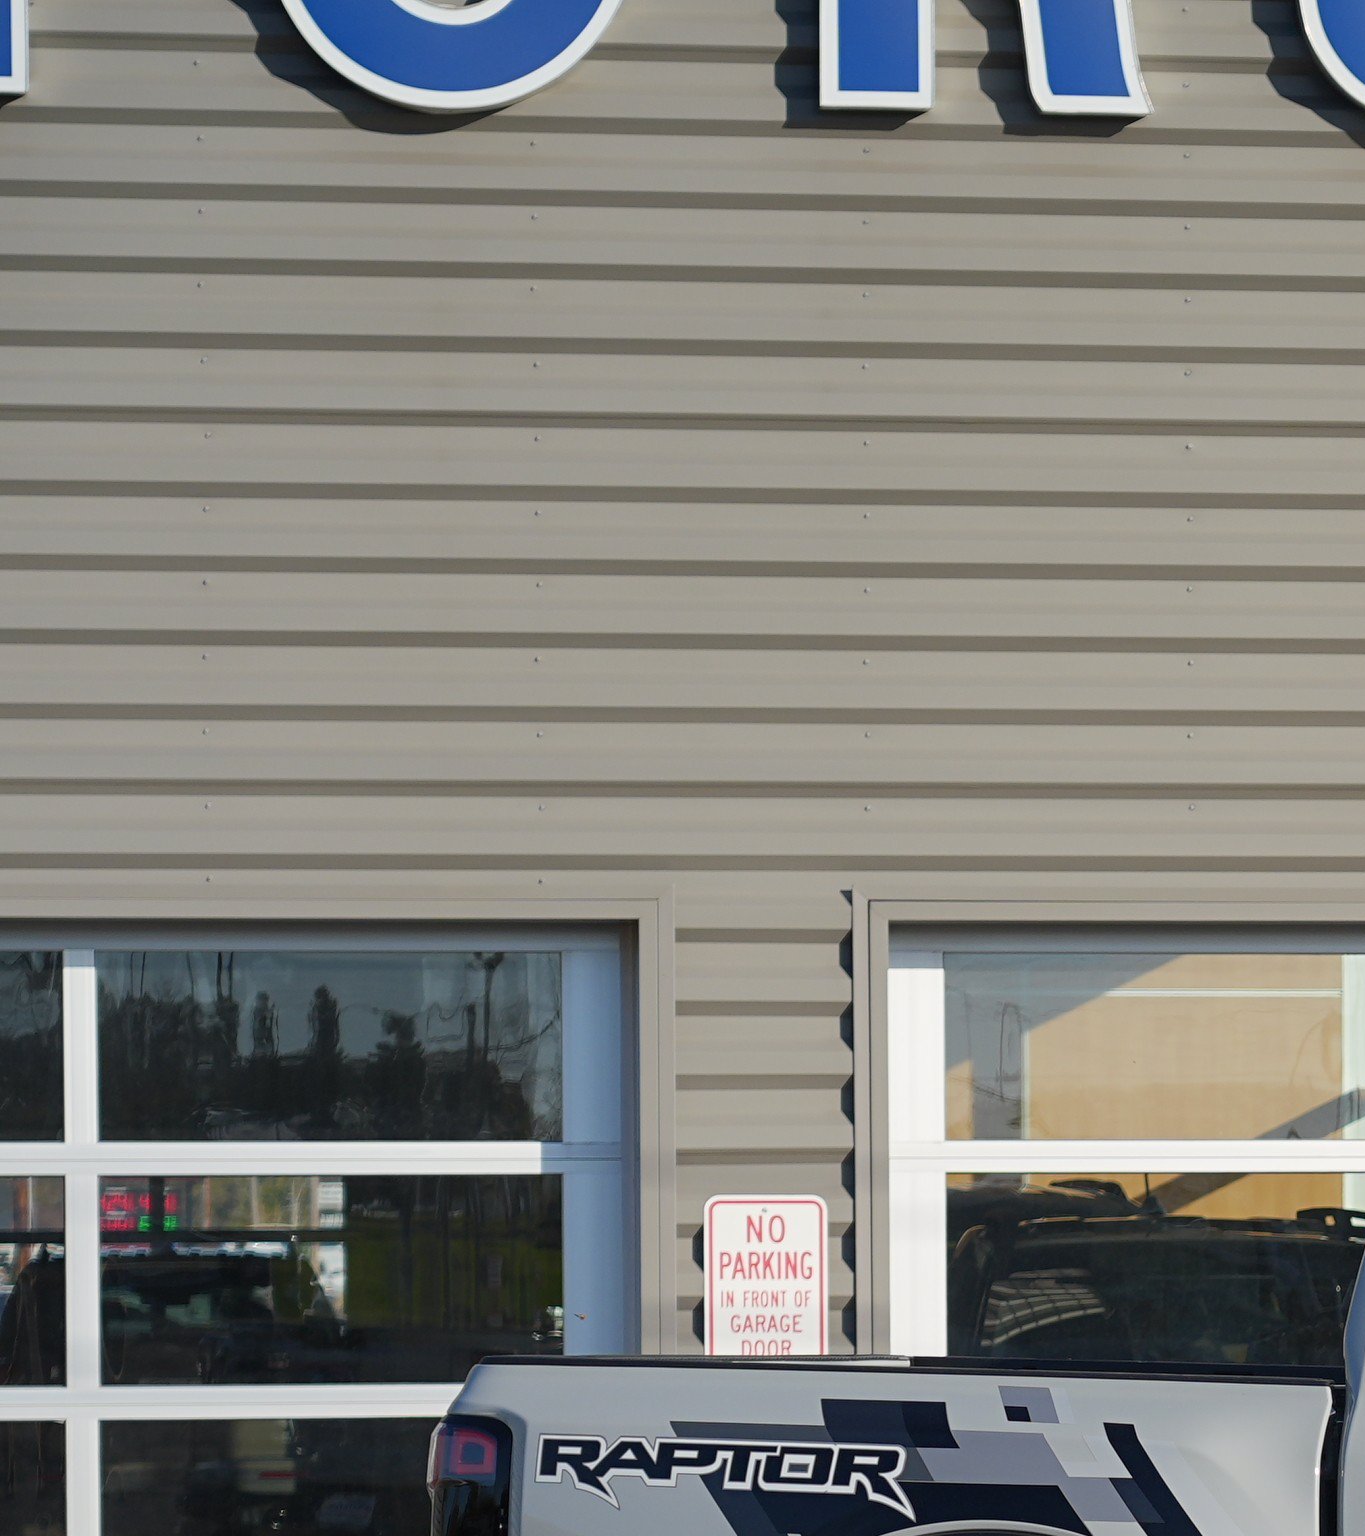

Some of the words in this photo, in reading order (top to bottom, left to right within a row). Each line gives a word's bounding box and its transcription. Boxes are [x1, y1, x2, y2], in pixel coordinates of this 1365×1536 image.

[746, 1215, 786, 1243] NO
[719, 1251, 814, 1279] PARKING
[720, 1290, 735, 1308] IN
[743, 1290, 786, 1308] FRONT
[794, 1290, 812, 1308] OF
[730, 1314, 803, 1333] GARAGE
[741, 1339, 792, 1356] DOOR
[534, 1432, 916, 1522] RAPTOR
